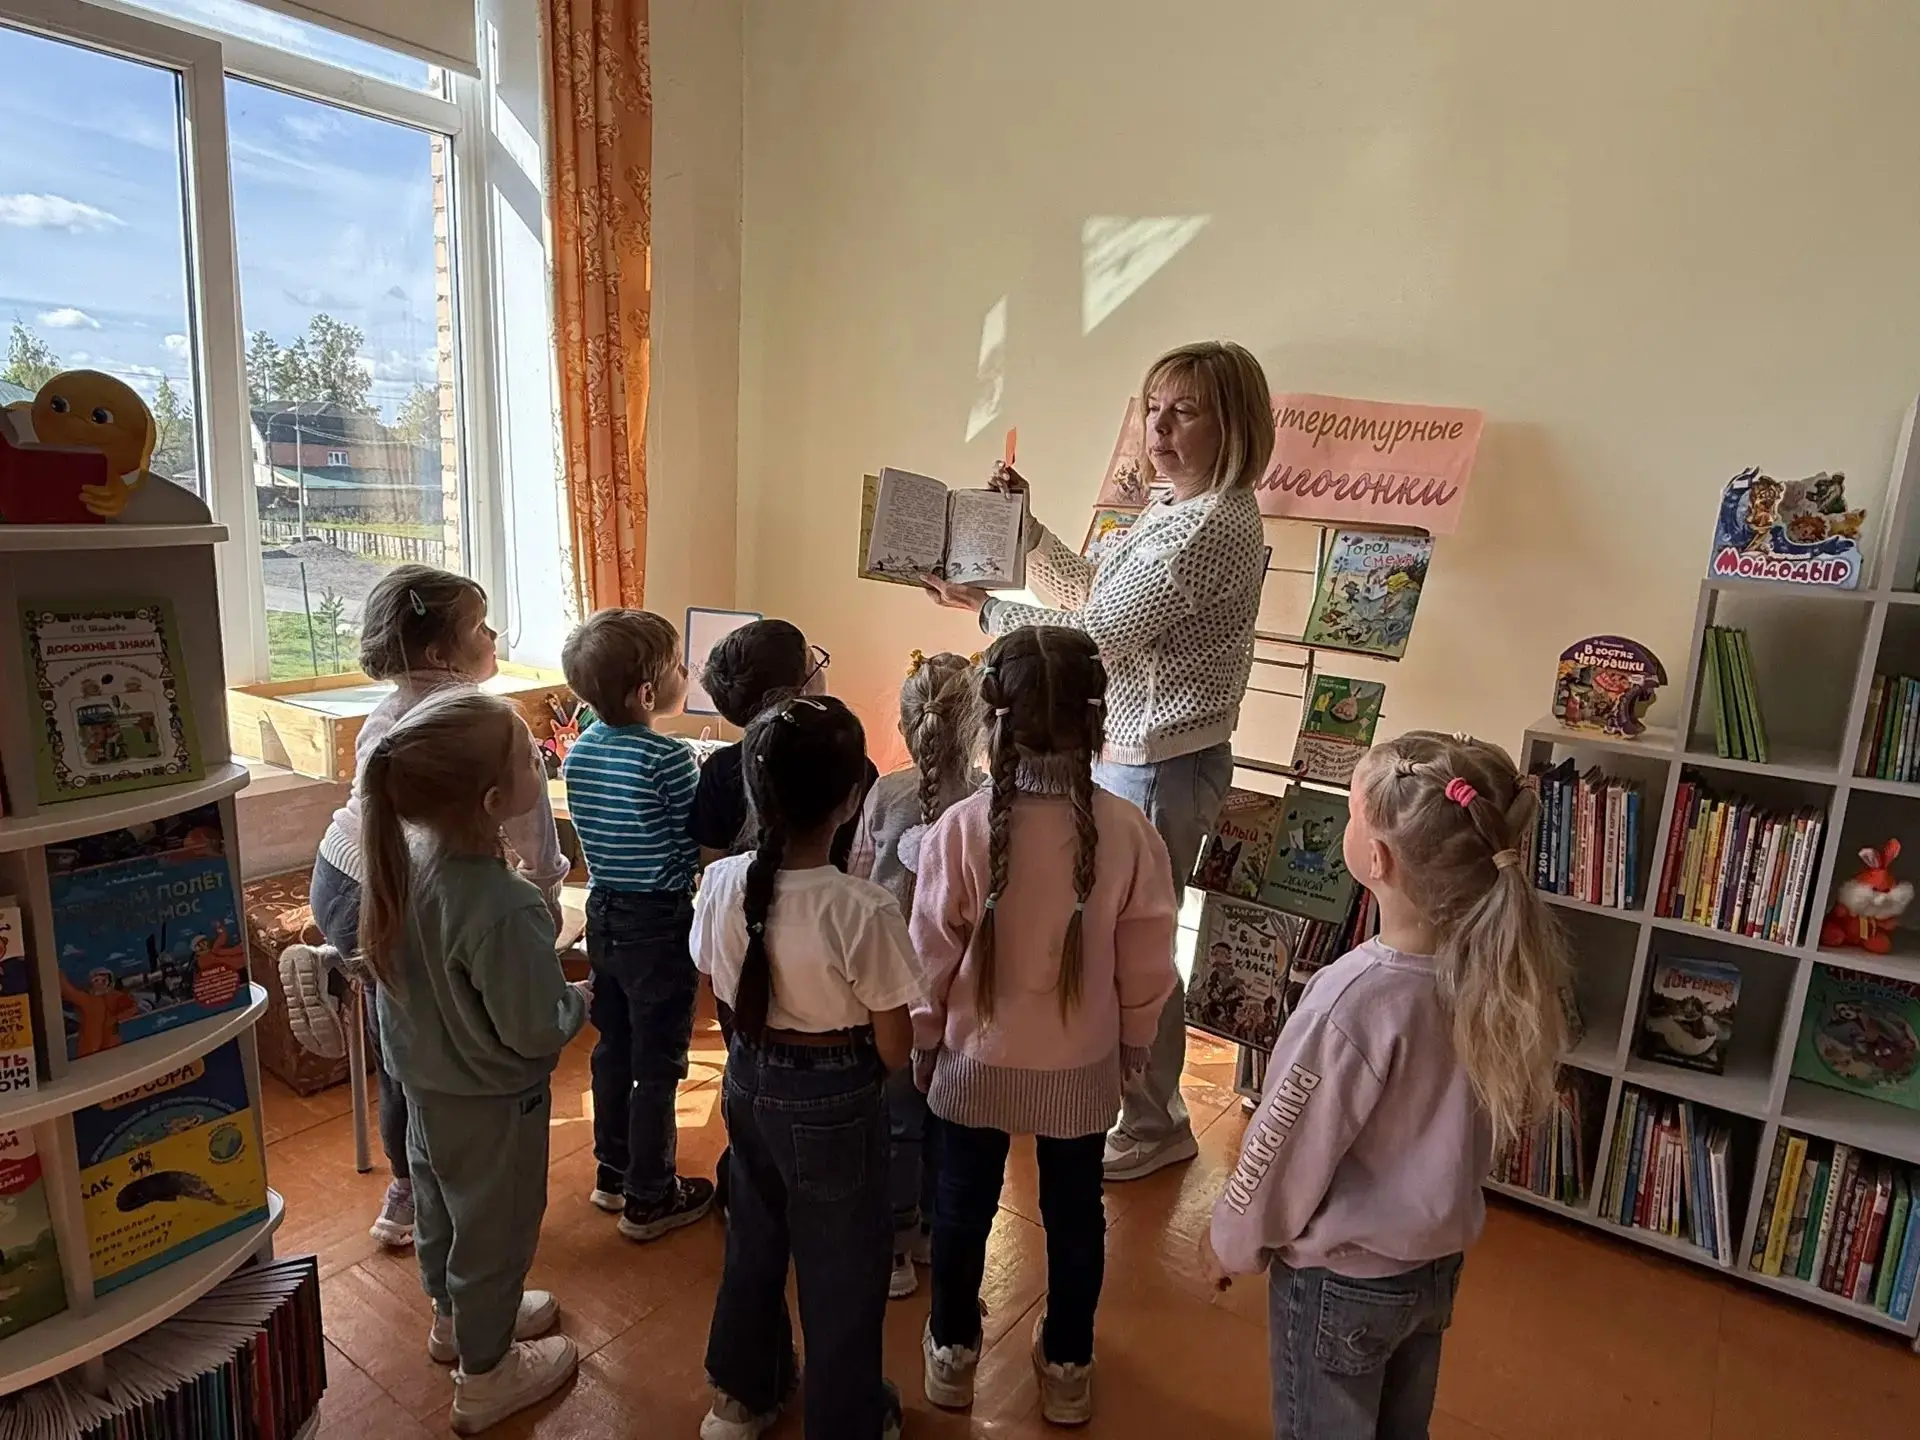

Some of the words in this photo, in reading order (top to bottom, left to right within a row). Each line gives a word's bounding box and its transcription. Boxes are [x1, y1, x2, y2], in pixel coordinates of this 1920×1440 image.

[1272, 407, 1464, 454] тературные
[1257, 463, 1458, 506] игогонки
[1715, 548, 1849, 583] Мойдодыр
[46, 641, 117, 655] ДОРОЖНЫЕ
[119, 638, 155, 650] ЗНАКИ
[1584, 644, 1593, 655] В
[1595, 648, 1634, 660] гостях
[157, 870, 224, 899] ПОЛЁТ
[1268, 1063, 1322, 1129] PAW
[1224, 1122, 1287, 1216] PATROL
